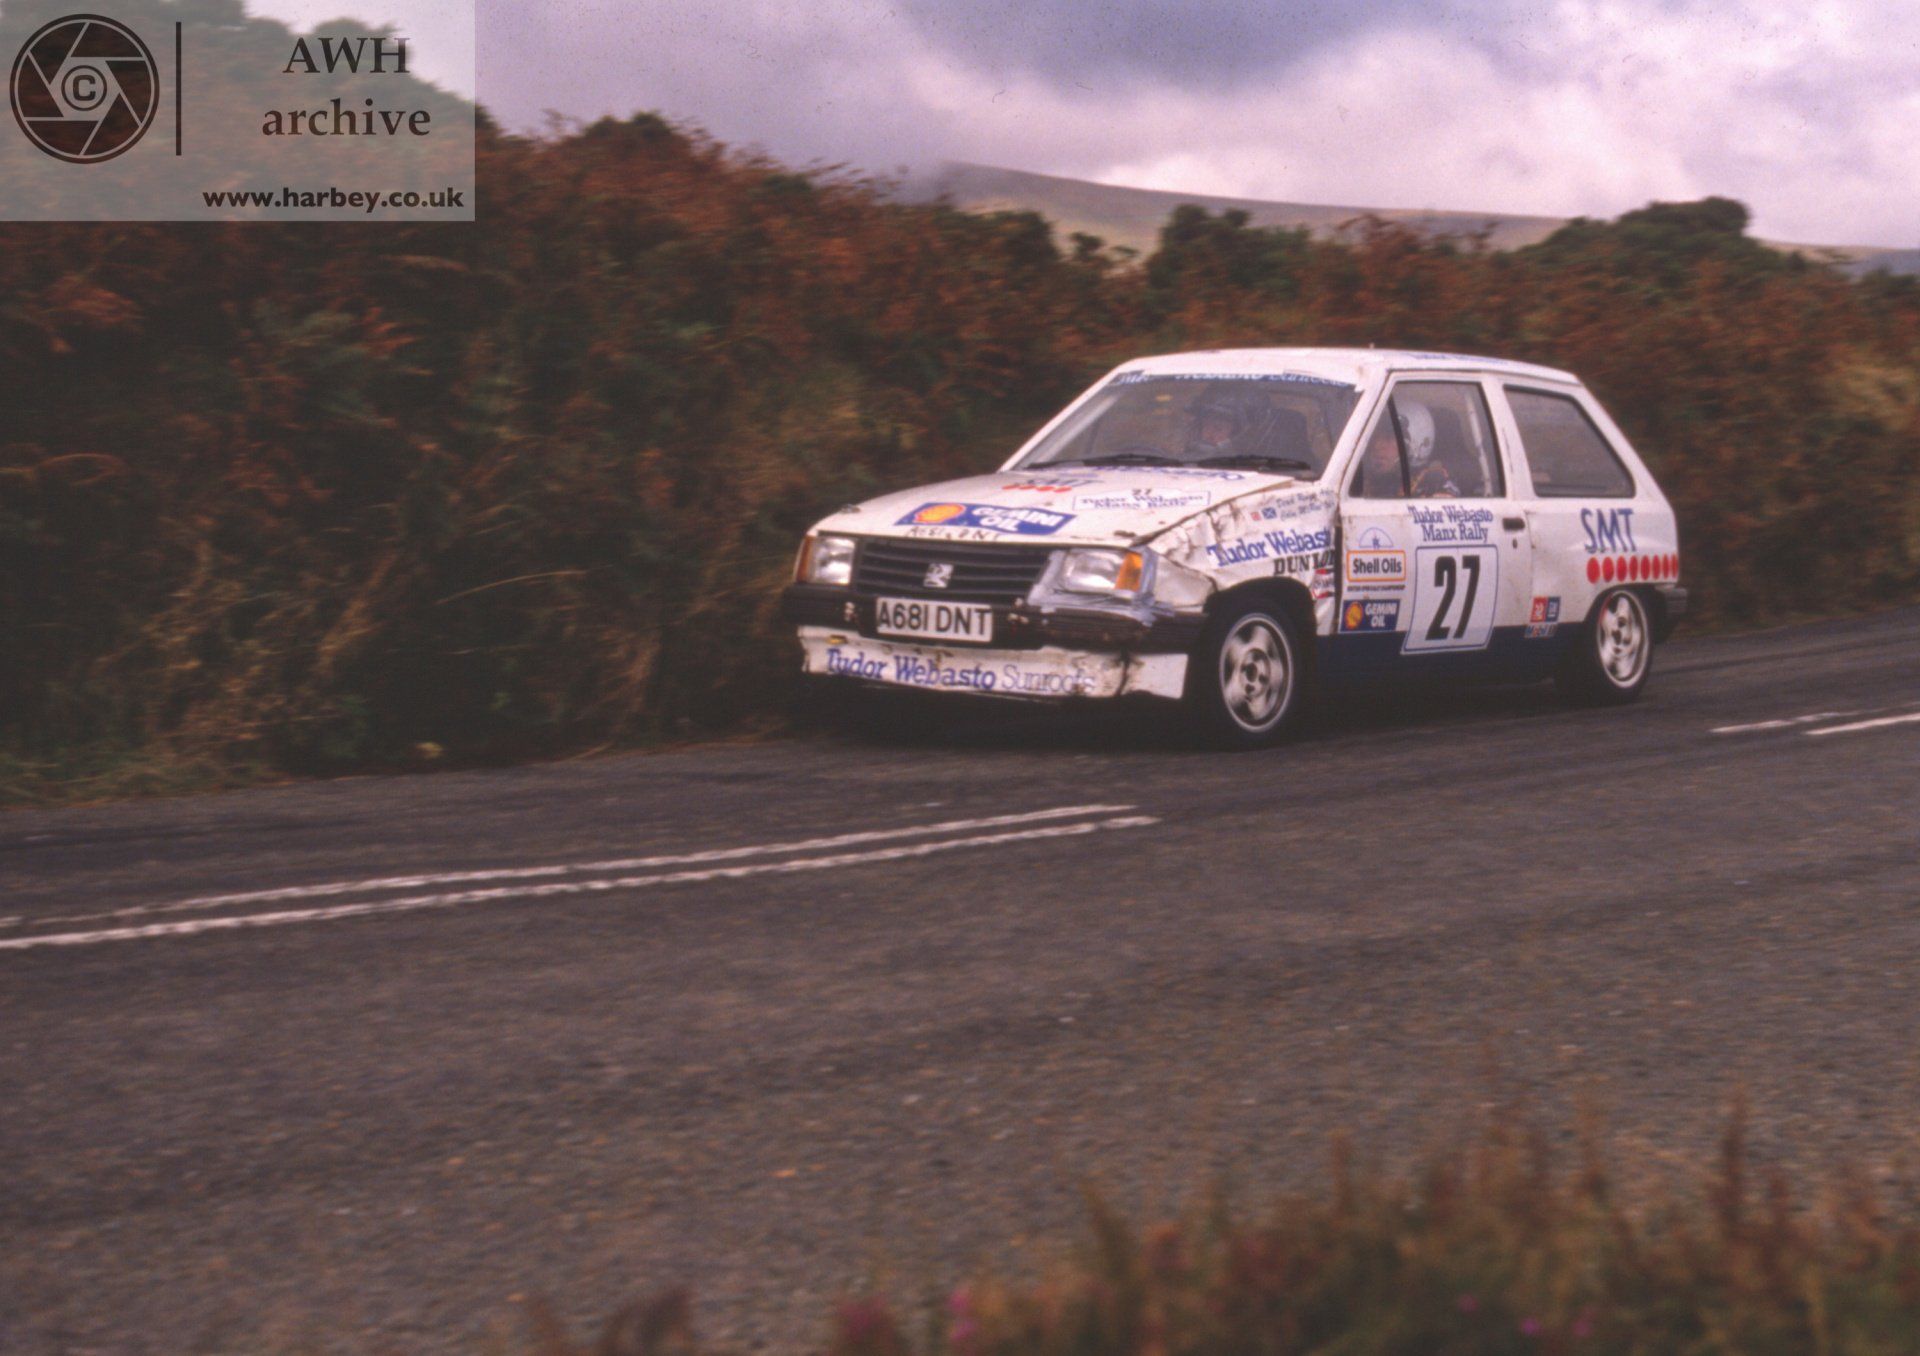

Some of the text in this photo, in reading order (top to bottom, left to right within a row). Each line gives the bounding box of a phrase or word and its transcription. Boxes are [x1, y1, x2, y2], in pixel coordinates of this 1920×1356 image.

[979, 516, 1020, 532] OIL
[1408, 505, 1494, 524] Tudor Webasto
[1421, 522, 1490, 543] Manx Rally
[1581, 508, 1634, 554] SMT
[1207, 540, 1273, 567] Tudor
[1353, 557, 1402, 574] Shell Oils
[1364, 602, 1398, 615] GEMINI
[1426, 555, 1481, 641] 27
[878, 601, 992, 636] A681 DNT
[1370, 615, 1386, 628] OIL
[827, 647, 888, 680] Tudor
[894, 655, 997, 690] Webasto
